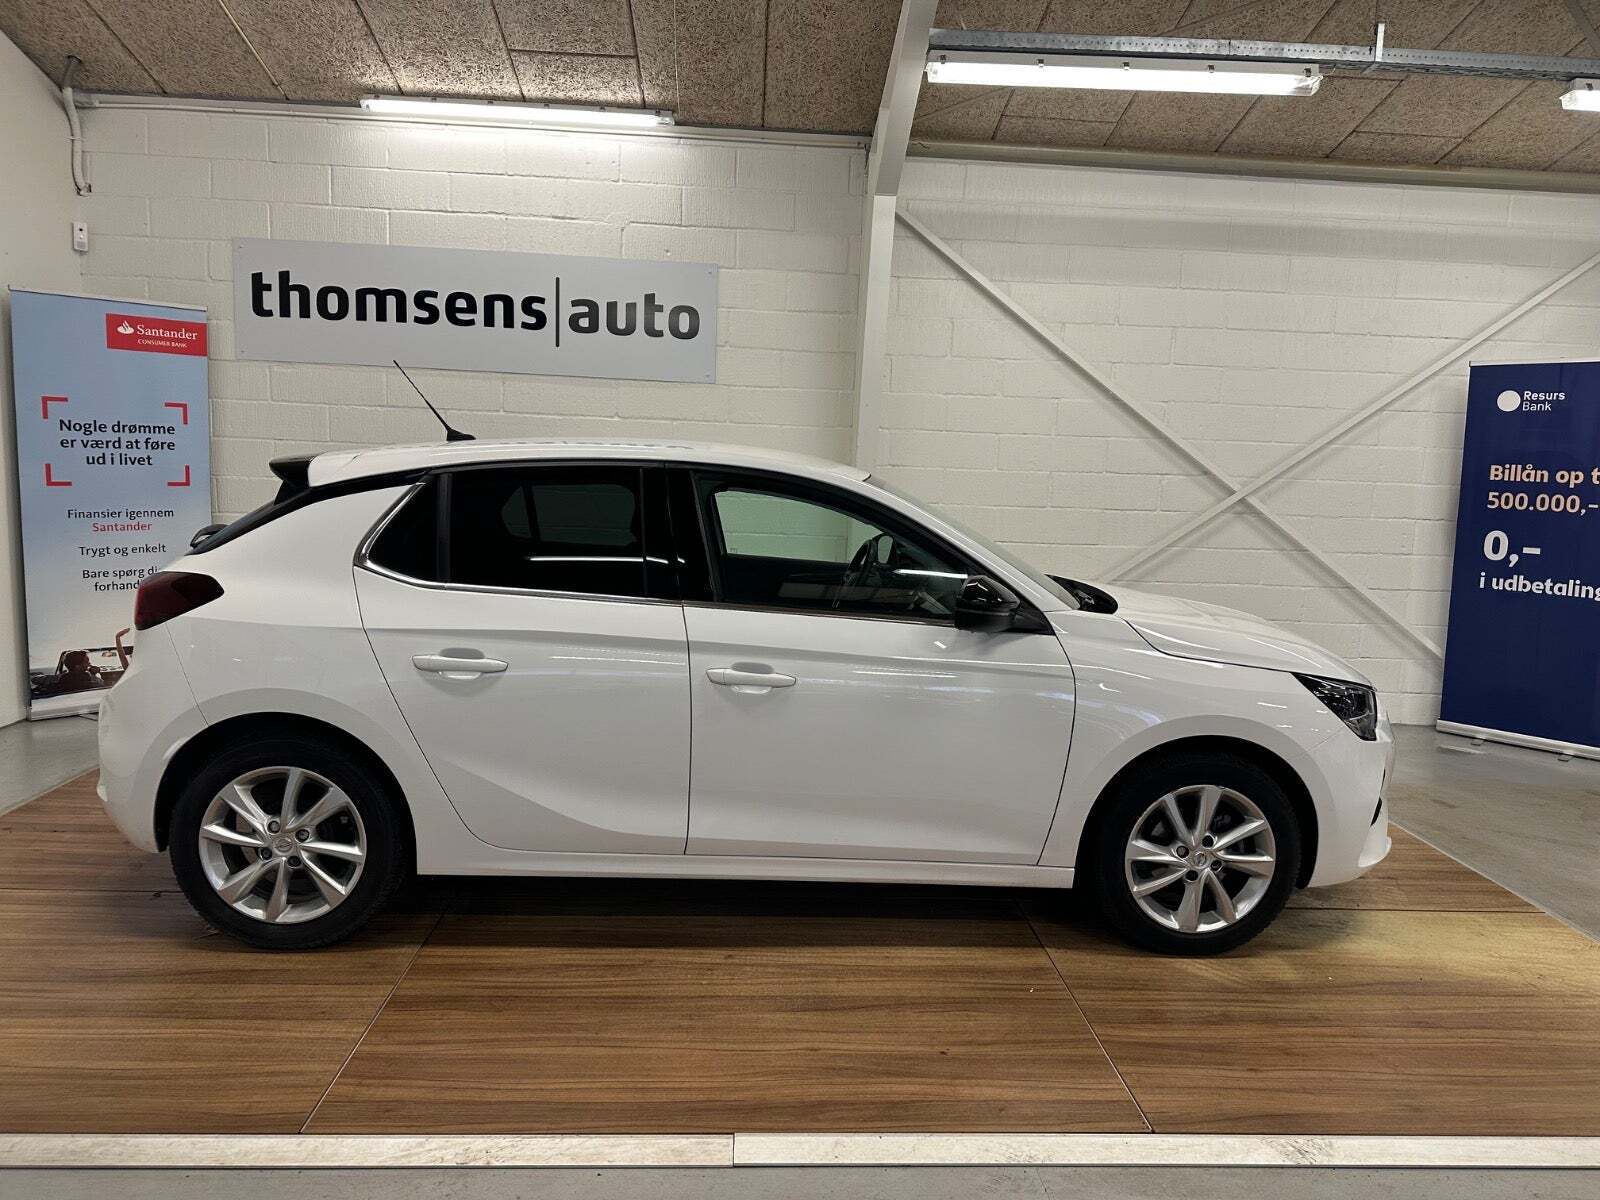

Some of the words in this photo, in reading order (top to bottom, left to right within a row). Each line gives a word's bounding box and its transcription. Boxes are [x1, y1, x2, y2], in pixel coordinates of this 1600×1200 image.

[251, 270, 547, 331] thomsens
[568, 293, 701, 340] auto
[136, 324, 198, 340] Santander
[137, 339, 171, 347] CONSUMER
[171, 341, 188, 349] BANK
[1523, 390, 1566, 401] Resurs
[1522, 401, 1552, 411] Bank
[59, 419, 108, 436] Nogle
[111, 421, 176, 435] drømme
[60, 438, 76, 448] er
[81, 437, 122, 449] værd
[125, 438, 141, 450] at
[144, 438, 176, 451] føre
[86, 453, 106, 465] ud
[110, 452, 115, 465] i
[119, 453, 153, 466] livet
[1489, 464, 1549, 483] Billån
[1555, 470, 1585, 488] op
[1487, 491, 1599, 516] 500.000,-
[67, 509, 122, 519] Finansier
[125, 508, 174, 520] igennem
[92, 522, 153, 532] Santander
[79, 546, 111, 557] Trygt
[113, 547, 129, 556] og
[131, 543, 167, 553] enkelt
[1483, 530, 1541, 568] 0,-
[82, 569, 110, 579] Bare
[112, 568, 145, 579] spørg
[147, 566, 161, 575] di
[94, 579, 144, 591] forhand
[1479, 571, 1486, 589] i
